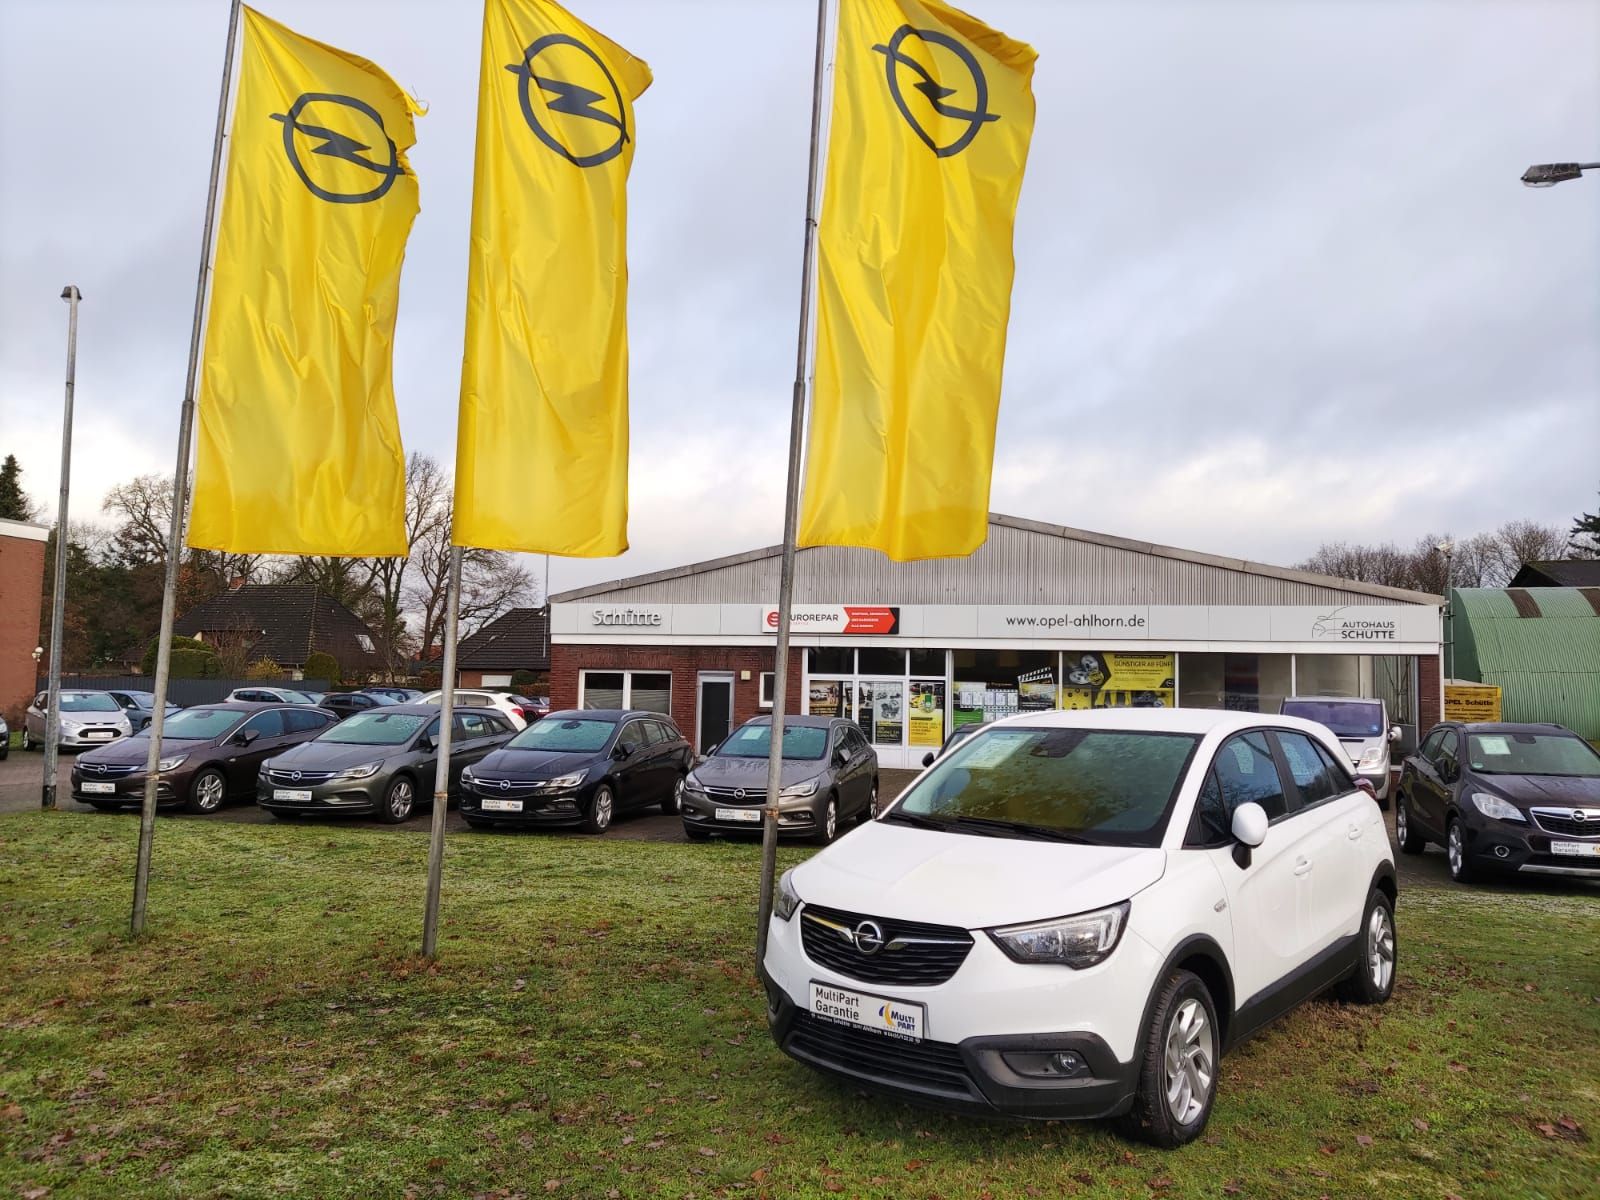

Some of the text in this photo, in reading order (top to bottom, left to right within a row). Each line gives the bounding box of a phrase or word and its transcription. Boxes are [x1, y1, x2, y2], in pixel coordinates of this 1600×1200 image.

[592, 608, 662, 626] Schütte
[789, 614, 839, 622] UROREPAR
[1006, 613, 1146, 629] www.opel-ahlhorn.de
[1342, 621, 1395, 629] AUTOHAUS
[816, 987, 860, 1008] MultiPart
[815, 1000, 860, 1021] Garantie
[891, 1010, 915, 1024] MULTI
[897, 1021, 916, 1032] PART
